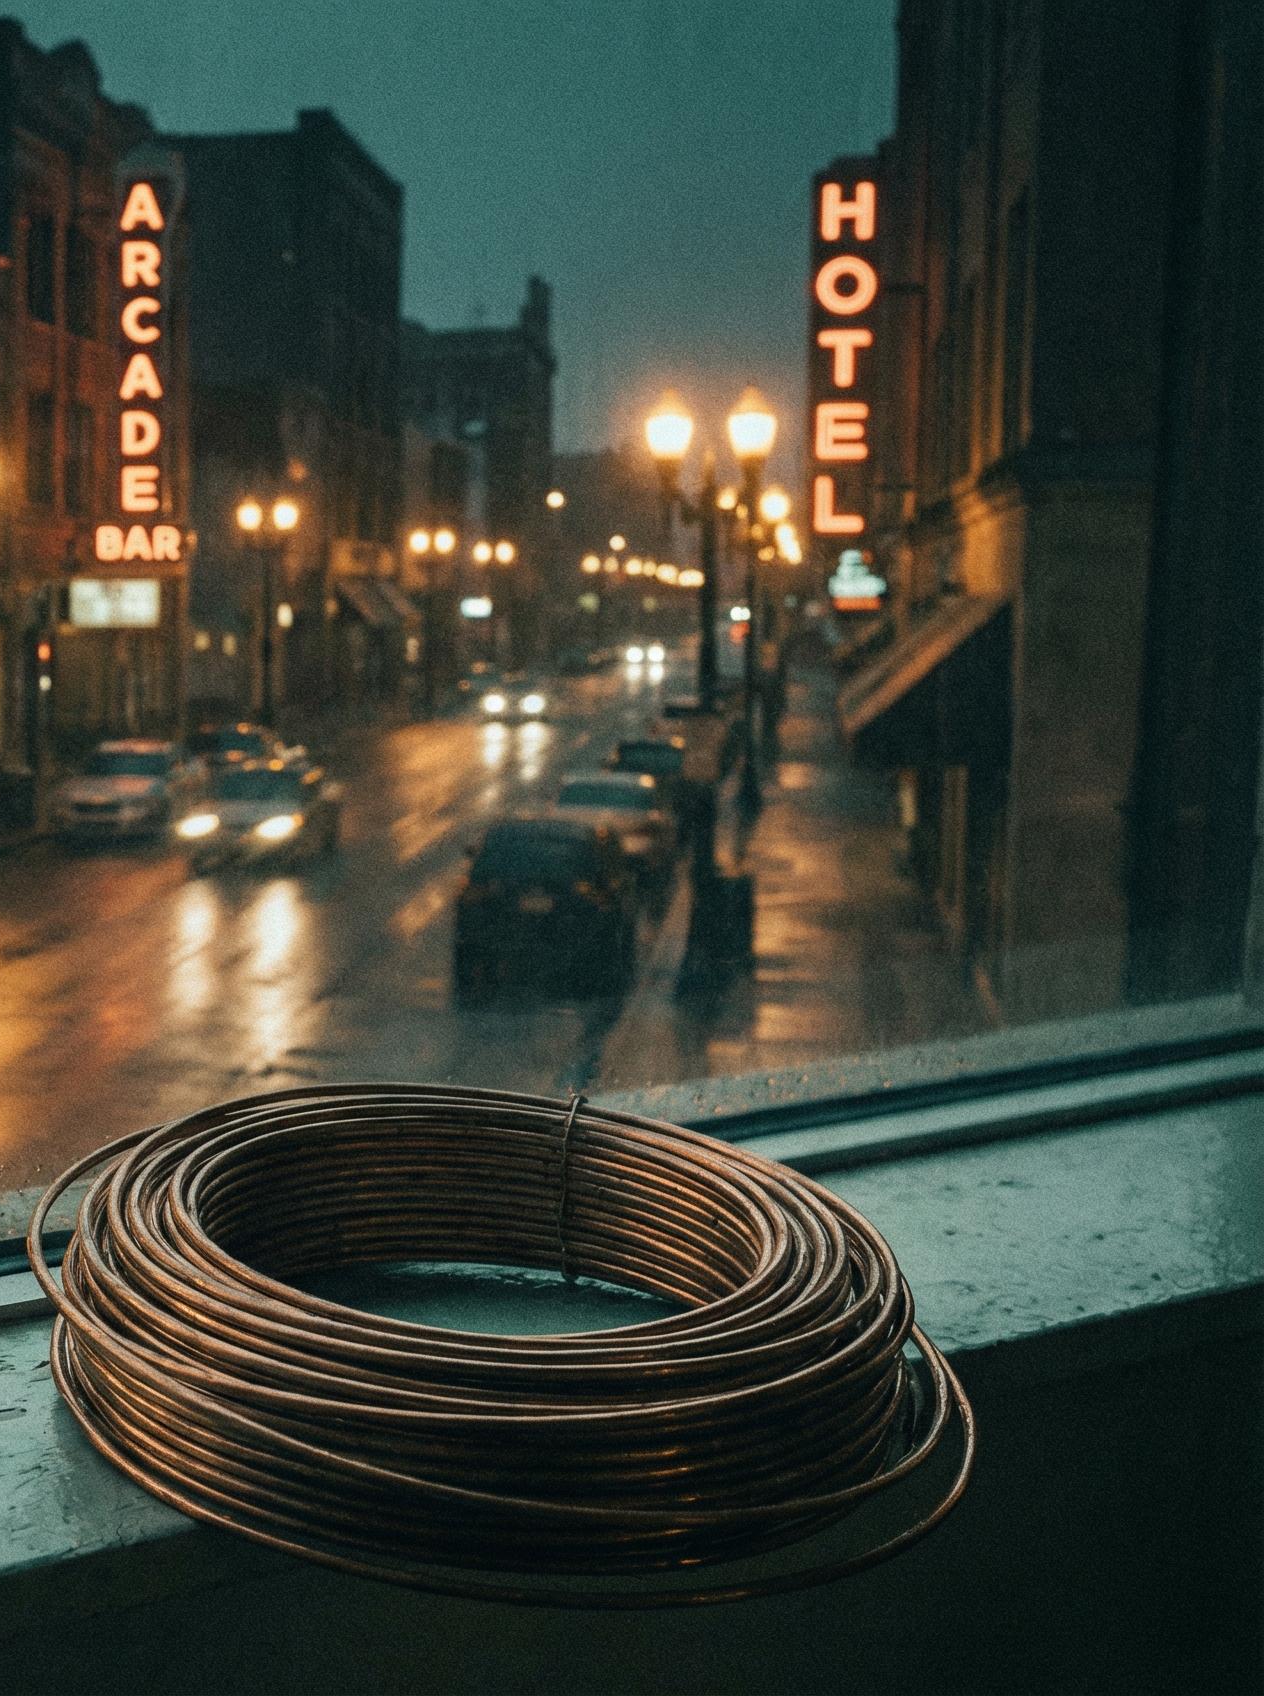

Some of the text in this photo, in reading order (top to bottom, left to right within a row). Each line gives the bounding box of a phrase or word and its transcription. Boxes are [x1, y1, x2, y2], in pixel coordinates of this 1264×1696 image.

[118, 182, 165, 511] ARCADE
[814, 181, 878, 533] HOTEL
[95, 524, 182, 561] BAR
